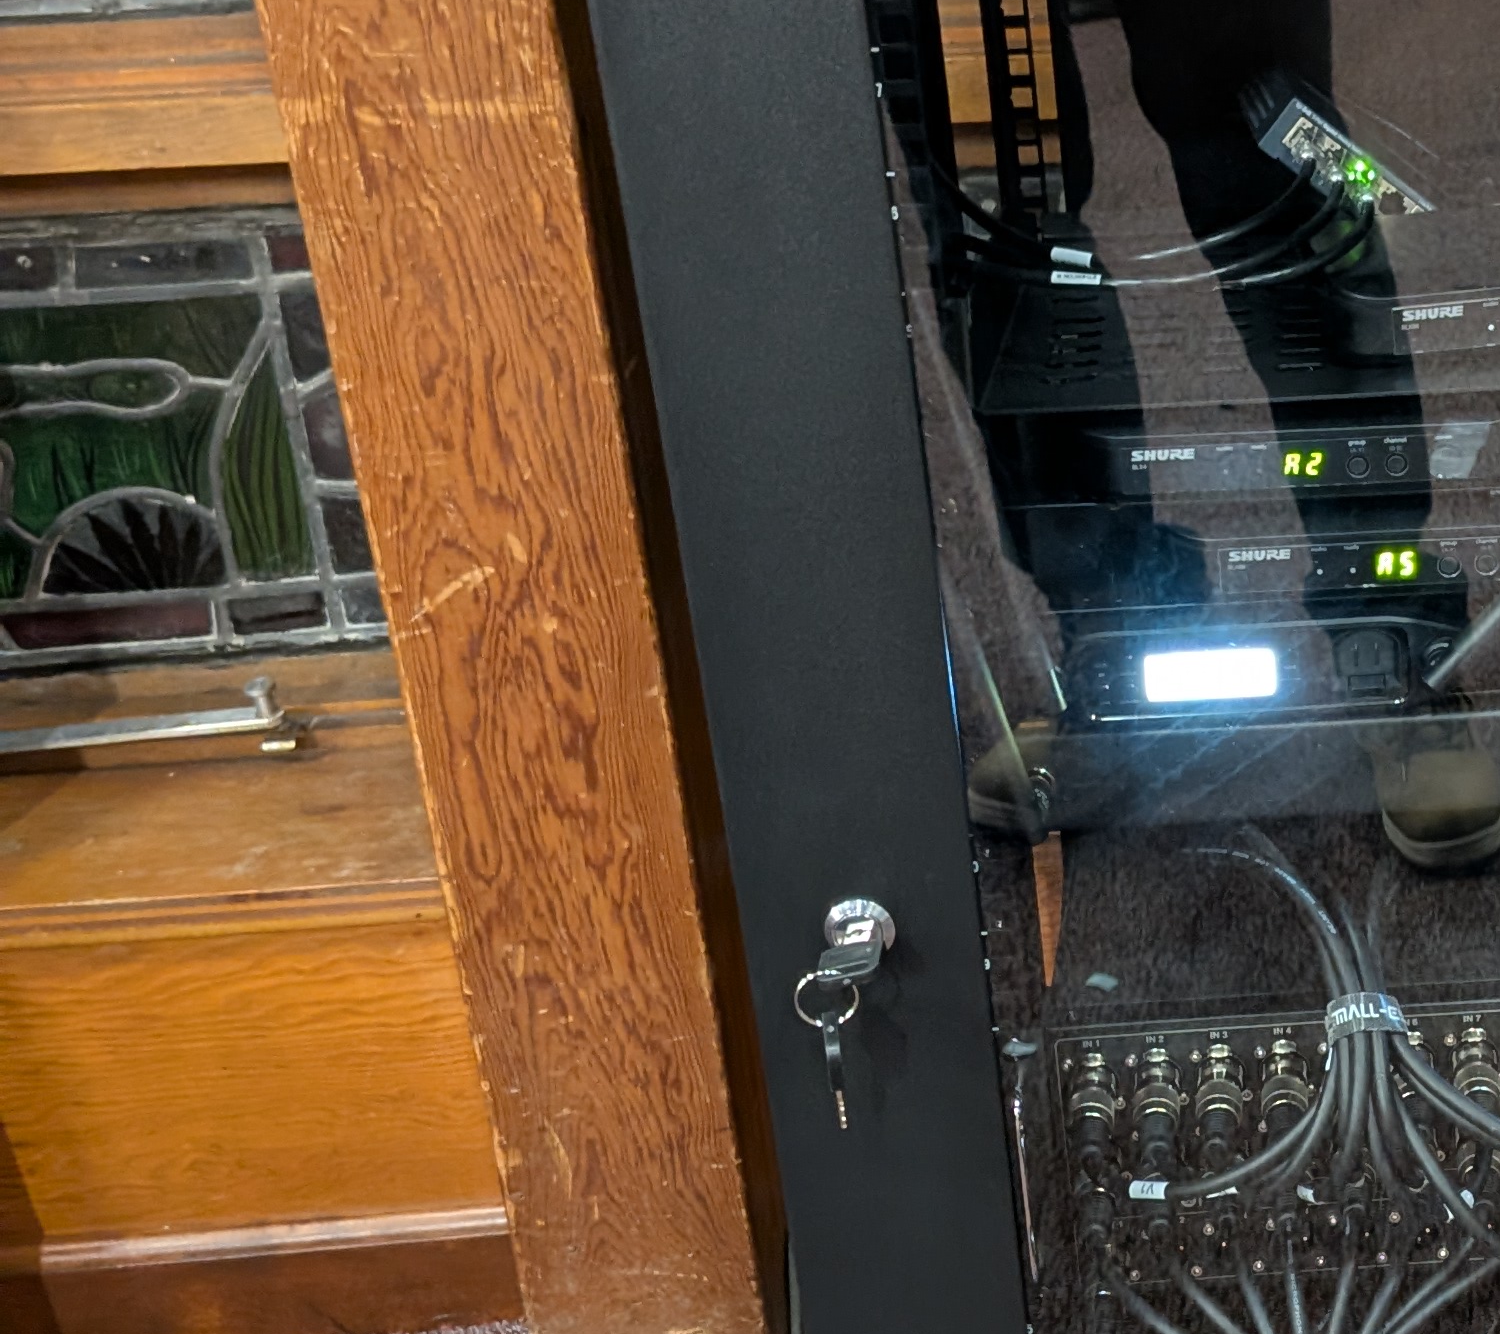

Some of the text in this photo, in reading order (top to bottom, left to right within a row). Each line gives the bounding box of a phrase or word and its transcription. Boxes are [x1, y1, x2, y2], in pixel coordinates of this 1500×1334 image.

[1402, 305, 1464, 322] SHURE
[1131, 448, 1195, 462] SHURE
[1284, 452, 1323, 475] A2
[1228, 548, 1291, 562] SHURE
[1376, 550, 1415, 576] A5
